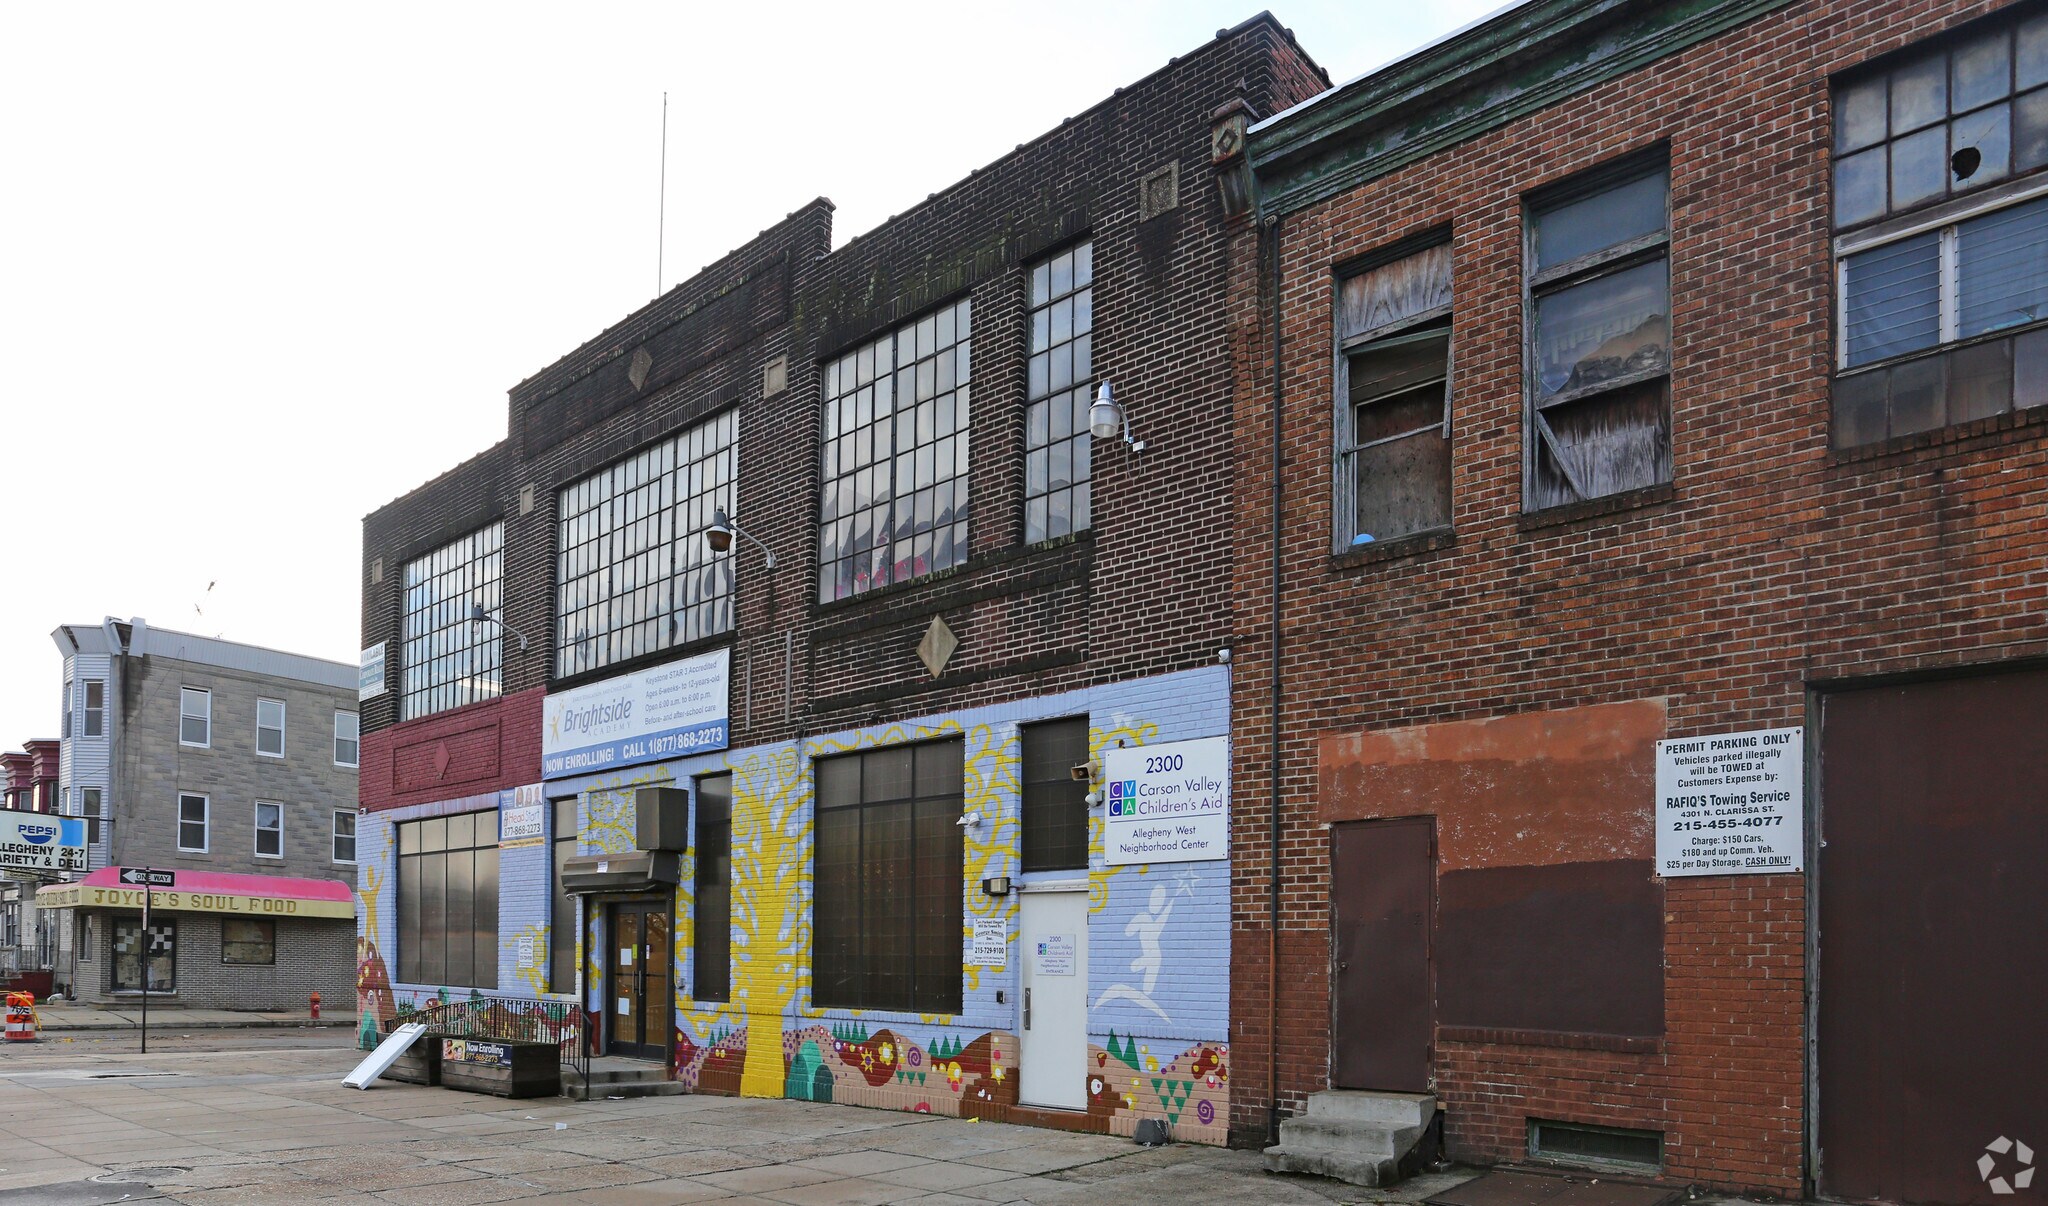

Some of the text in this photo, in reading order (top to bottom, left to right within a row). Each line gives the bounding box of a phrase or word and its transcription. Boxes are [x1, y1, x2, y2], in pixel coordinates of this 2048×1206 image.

[646, 674, 668, 685] Keystone
[669, 669, 683, 679] STAR
[688, 661, 717, 674] Accredited
[645, 704, 658, 712] Open
[659, 699, 669, 708] 6:00
[688, 693, 699, 702] 6:00
[700, 692, 711, 700] p.m.
[646, 690, 658, 699] Ages
[564, 697, 632, 733] Brightside
[663, 713, 672, 721] and
[674, 706, 703, 720] after-school
[705, 704, 716, 713] care
[588, 721, 632, 736] ACADEMY
[1666, 733, 1791, 754] PERMIT PARKING ONLY
[546, 758, 564, 773] NOW
[566, 747, 614, 769] ENROLLING!
[623, 742, 646, 759] CALL
[1146, 754, 1183, 774] 2300
[1675, 748, 1781, 766] Vehicles parked illegally
[1690, 761, 1764, 775] will be TOWED at
[1139, 776, 1222, 797] Carson Valley
[1678, 772, 1778, 788] Customers Expense by:
[1138, 793, 1222, 815] Children's Aid
[1667, 790, 1790, 808] RAFIQ'S Towing Service
[509, 810, 524, 823] Head
[526, 809, 540, 822] Start
[1716, 806, 1759, 816] CLARISSA
[18, 824, 56, 835] PEPSI
[504, 823, 540, 836] 877-868-2273
[1673, 816, 1783, 831] 215-455-4077
[1132, 826, 1196, 840] Allegheny West
[1692, 834, 1764, 846] Charge: $150 Cars,
[61, 848, 85, 858] 24-7
[1120, 840, 1209, 854] Neighborhood Center
[1682, 848, 1700, 857] $180
[1719, 848, 1727, 856] up
[1730, 847, 1755, 855] Comm.
[1758, 845, 1774, 853] Veh.
[44, 857, 52, 866] &
[59, 858, 83, 868] DELI
[1667, 856, 1791, 869] $25 per Day Storage. CASH ONLY!
[95, 890, 296, 913] JOYCE'S SOUL FOOD
[466, 1042, 504, 1057] Now Enrolling
